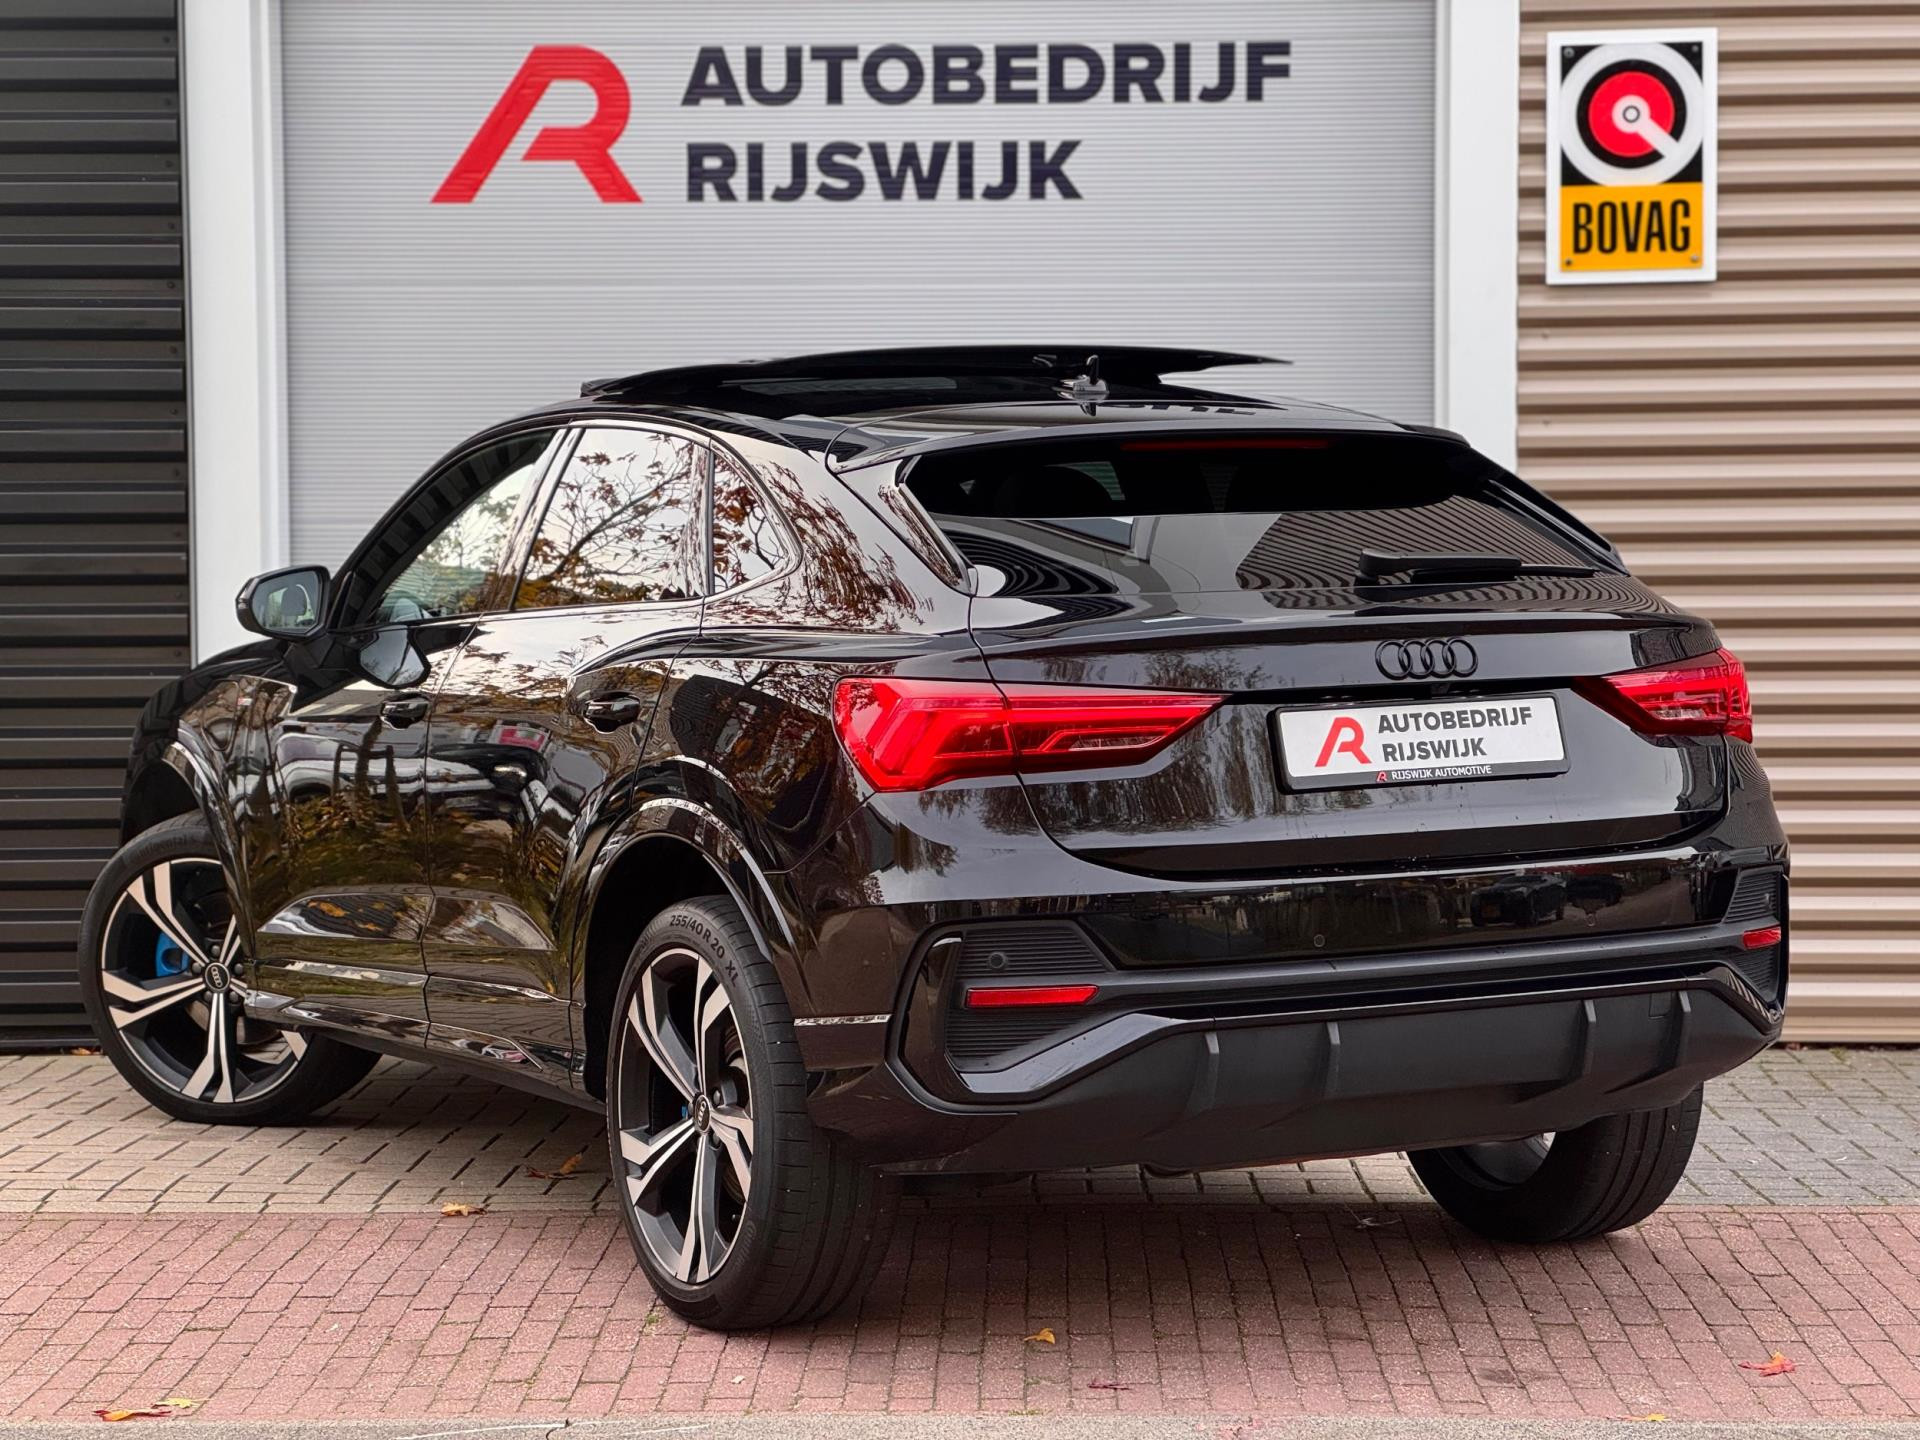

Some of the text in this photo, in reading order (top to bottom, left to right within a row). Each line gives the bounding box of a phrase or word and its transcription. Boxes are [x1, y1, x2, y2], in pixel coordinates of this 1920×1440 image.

[680, 41, 1291, 106] AUTOBEDRIJF
[686, 139, 1084, 203] RIJSWIJK
[1572, 198, 1690, 254] BOVAG
[1378, 706, 1533, 734] AUTOBEDRIJF
[1382, 737, 1488, 762] RIJSWIJK
[1391, 768, 1433, 780] RIJSWIJK
[1435, 765, 1492, 777] AUTOMOTIVE
[670, 915, 703, 935] 255/40
[711, 938, 725, 958] 20
